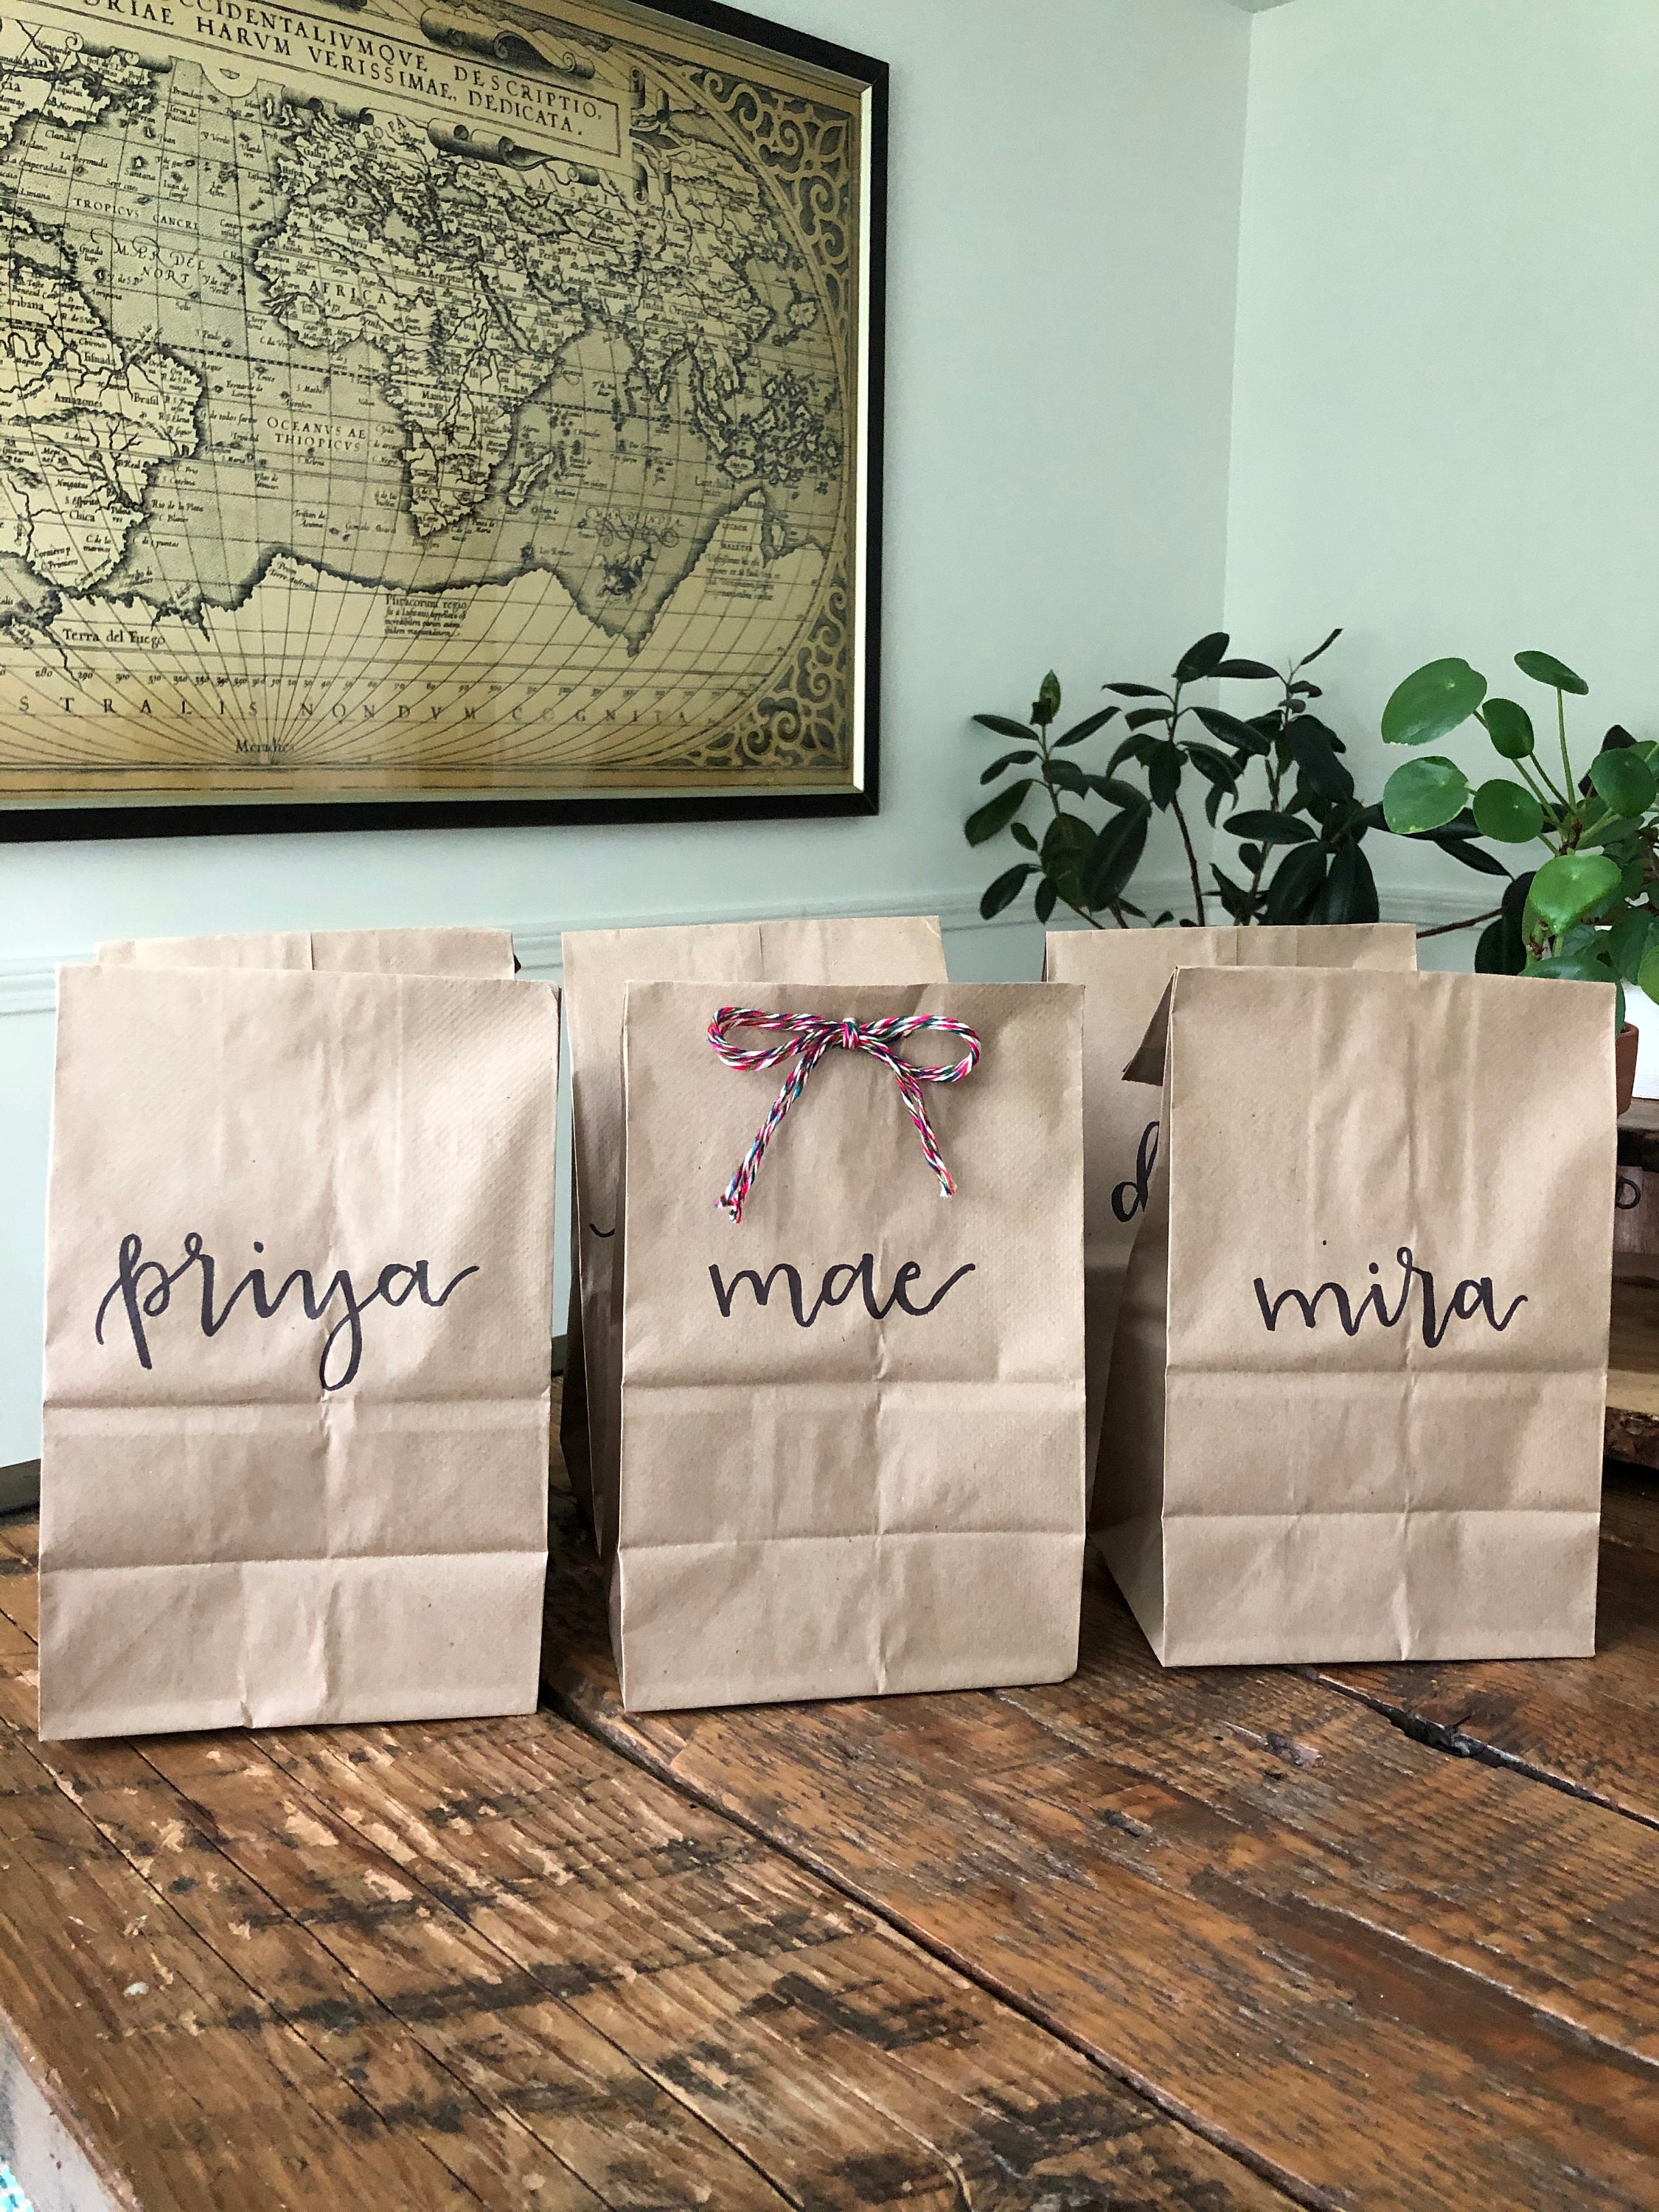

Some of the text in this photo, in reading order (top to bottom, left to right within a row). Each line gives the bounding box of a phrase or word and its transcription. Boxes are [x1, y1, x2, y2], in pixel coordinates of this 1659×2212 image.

[164, 0, 428, 72] CIDENTALIVMQVE
[196, 16, 291, 56] HARVM
[74, 197, 200, 230] TROPICVS CANCRI
[310, 279, 386, 305] AFRICA
[54, 392, 103, 408] Amazones
[267, 416, 366, 440] OCEANVS AE
[274, 433, 361, 453] THIOPICVS
[62, 627, 100, 642] Terra
[106, 627, 125, 643] del
[708, 1253, 976, 1328] mae
[1253, 1245, 1528, 1349] mira
[95, 1231, 480, 1391] priya
